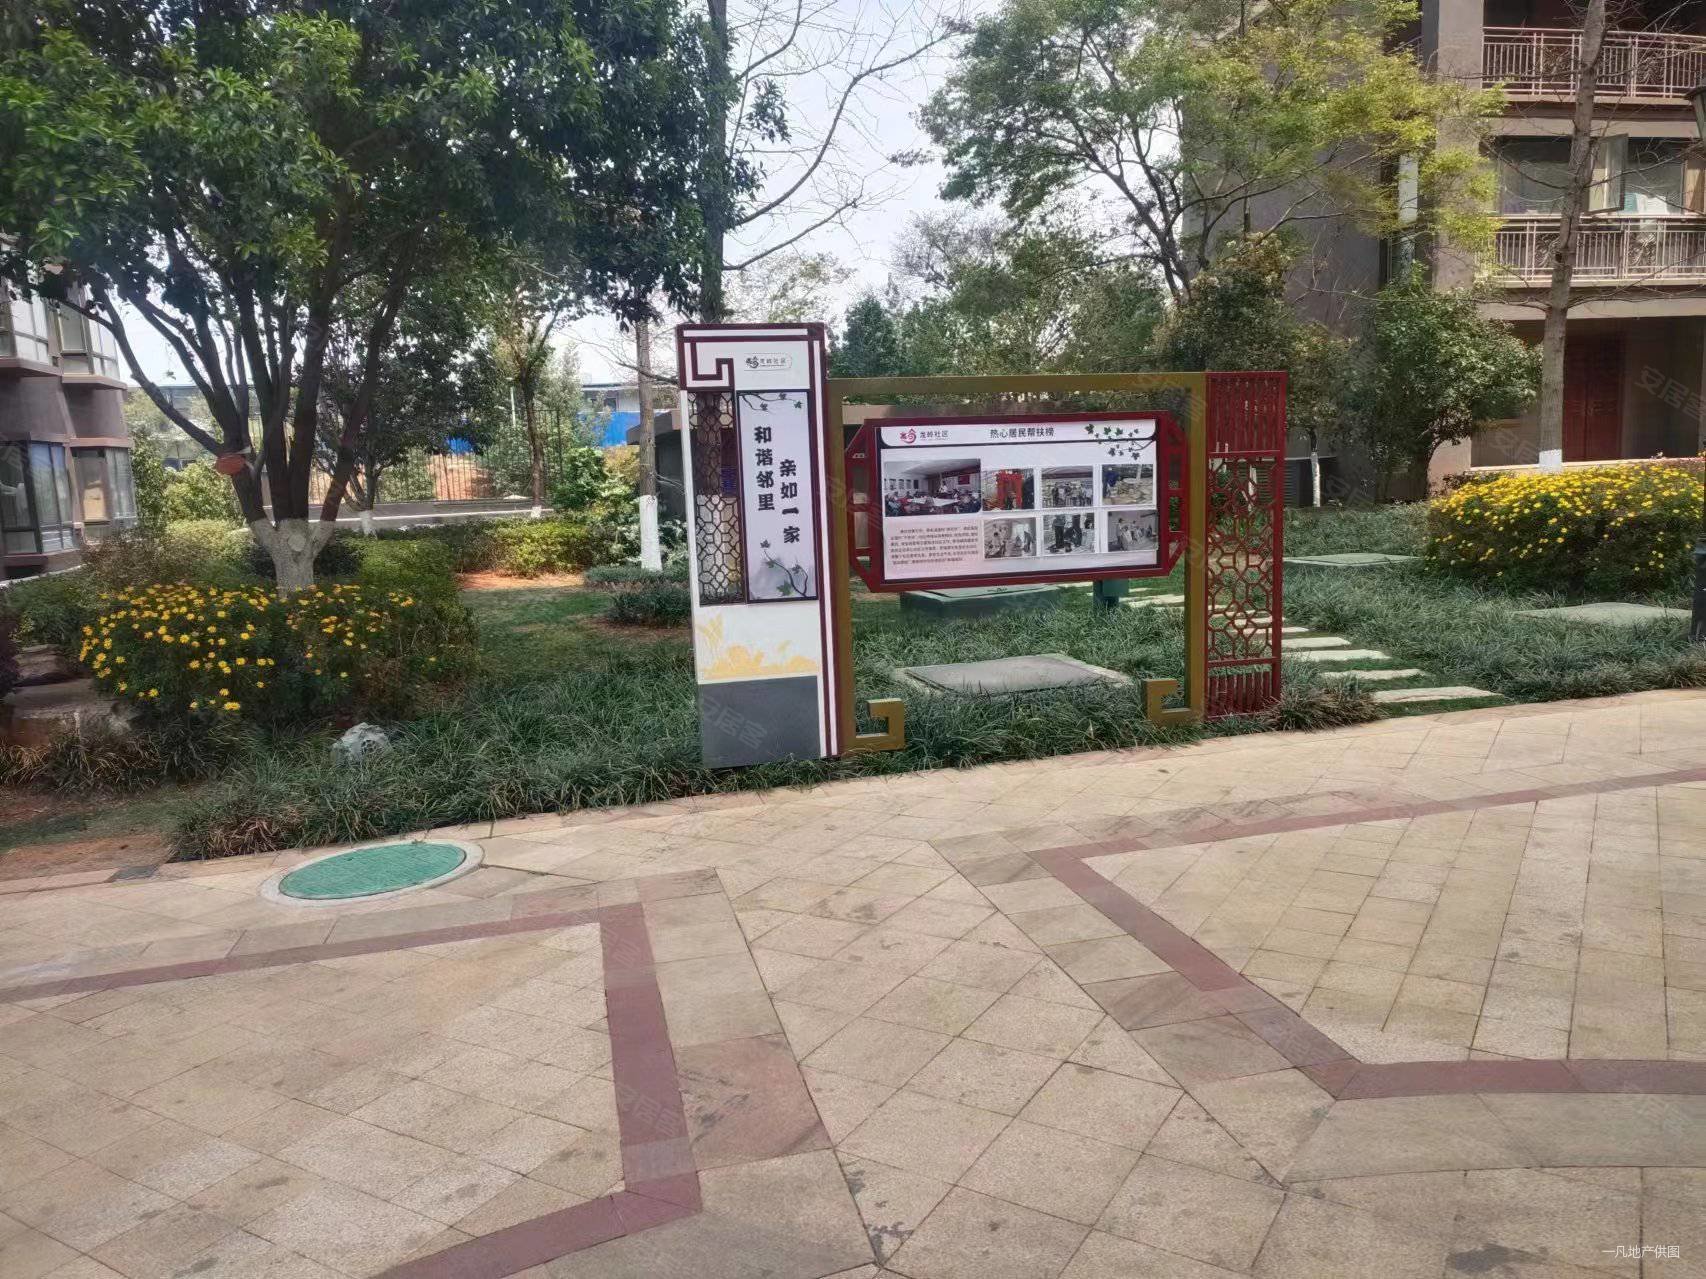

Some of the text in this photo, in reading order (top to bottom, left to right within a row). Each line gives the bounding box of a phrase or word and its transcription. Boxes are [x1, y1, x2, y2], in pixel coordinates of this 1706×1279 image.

[754, 426, 775, 511] 和谐邻里
[779, 459, 800, 544] 亲如一家
